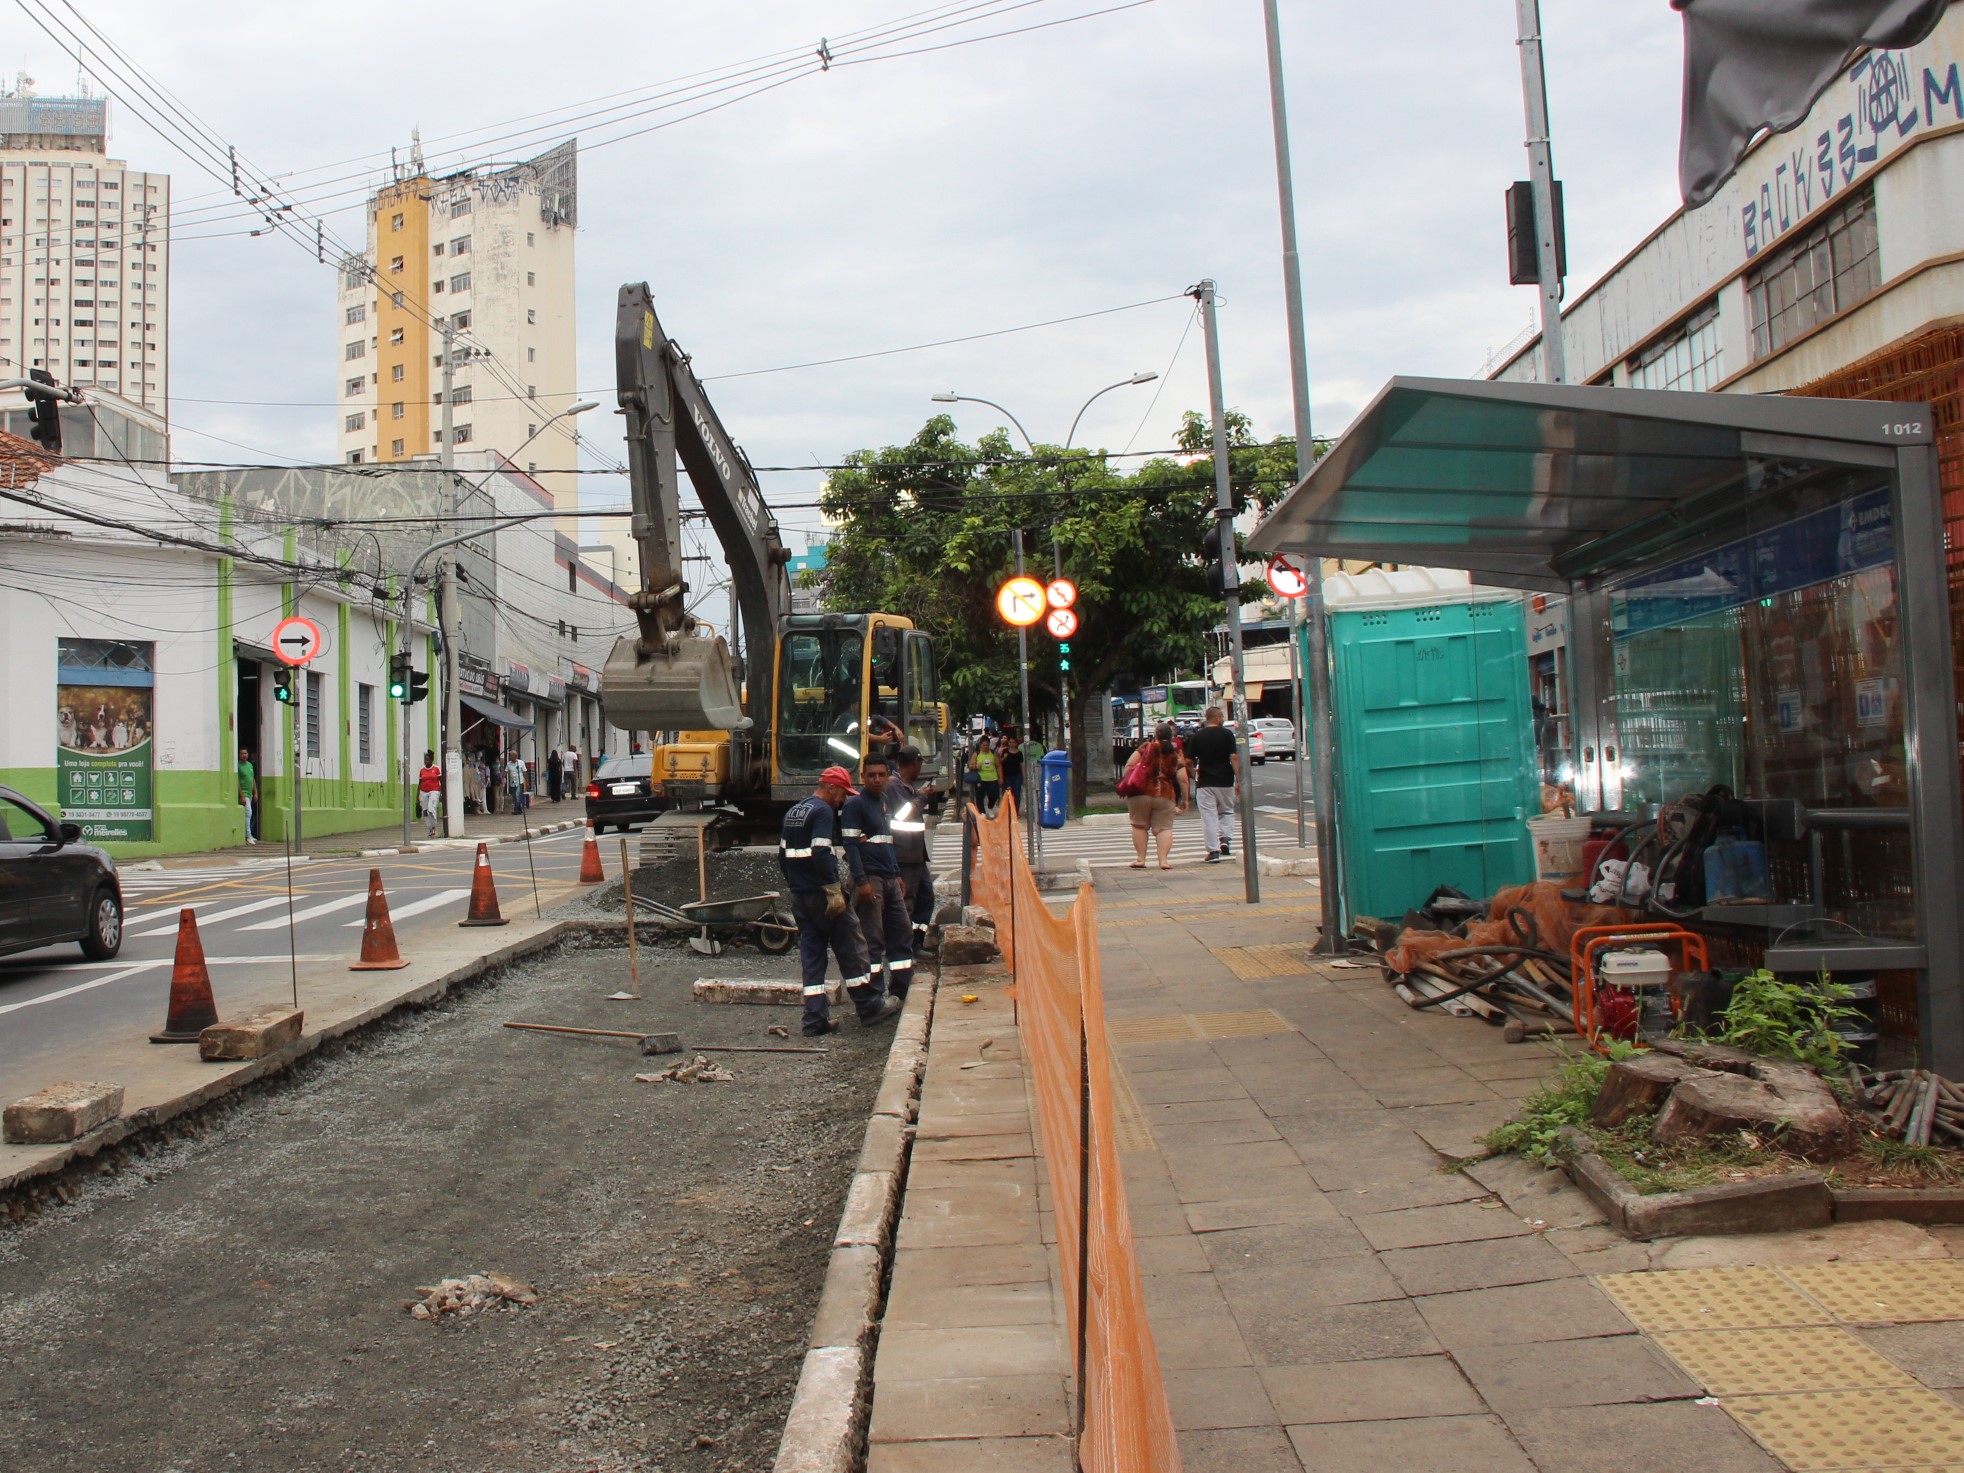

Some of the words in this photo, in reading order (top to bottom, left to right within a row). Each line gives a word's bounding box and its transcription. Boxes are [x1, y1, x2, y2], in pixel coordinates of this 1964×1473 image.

[693, 403, 731, 480] VOLVO
[79, 760, 90, 768] loja
[91, 760, 117, 768] completa
